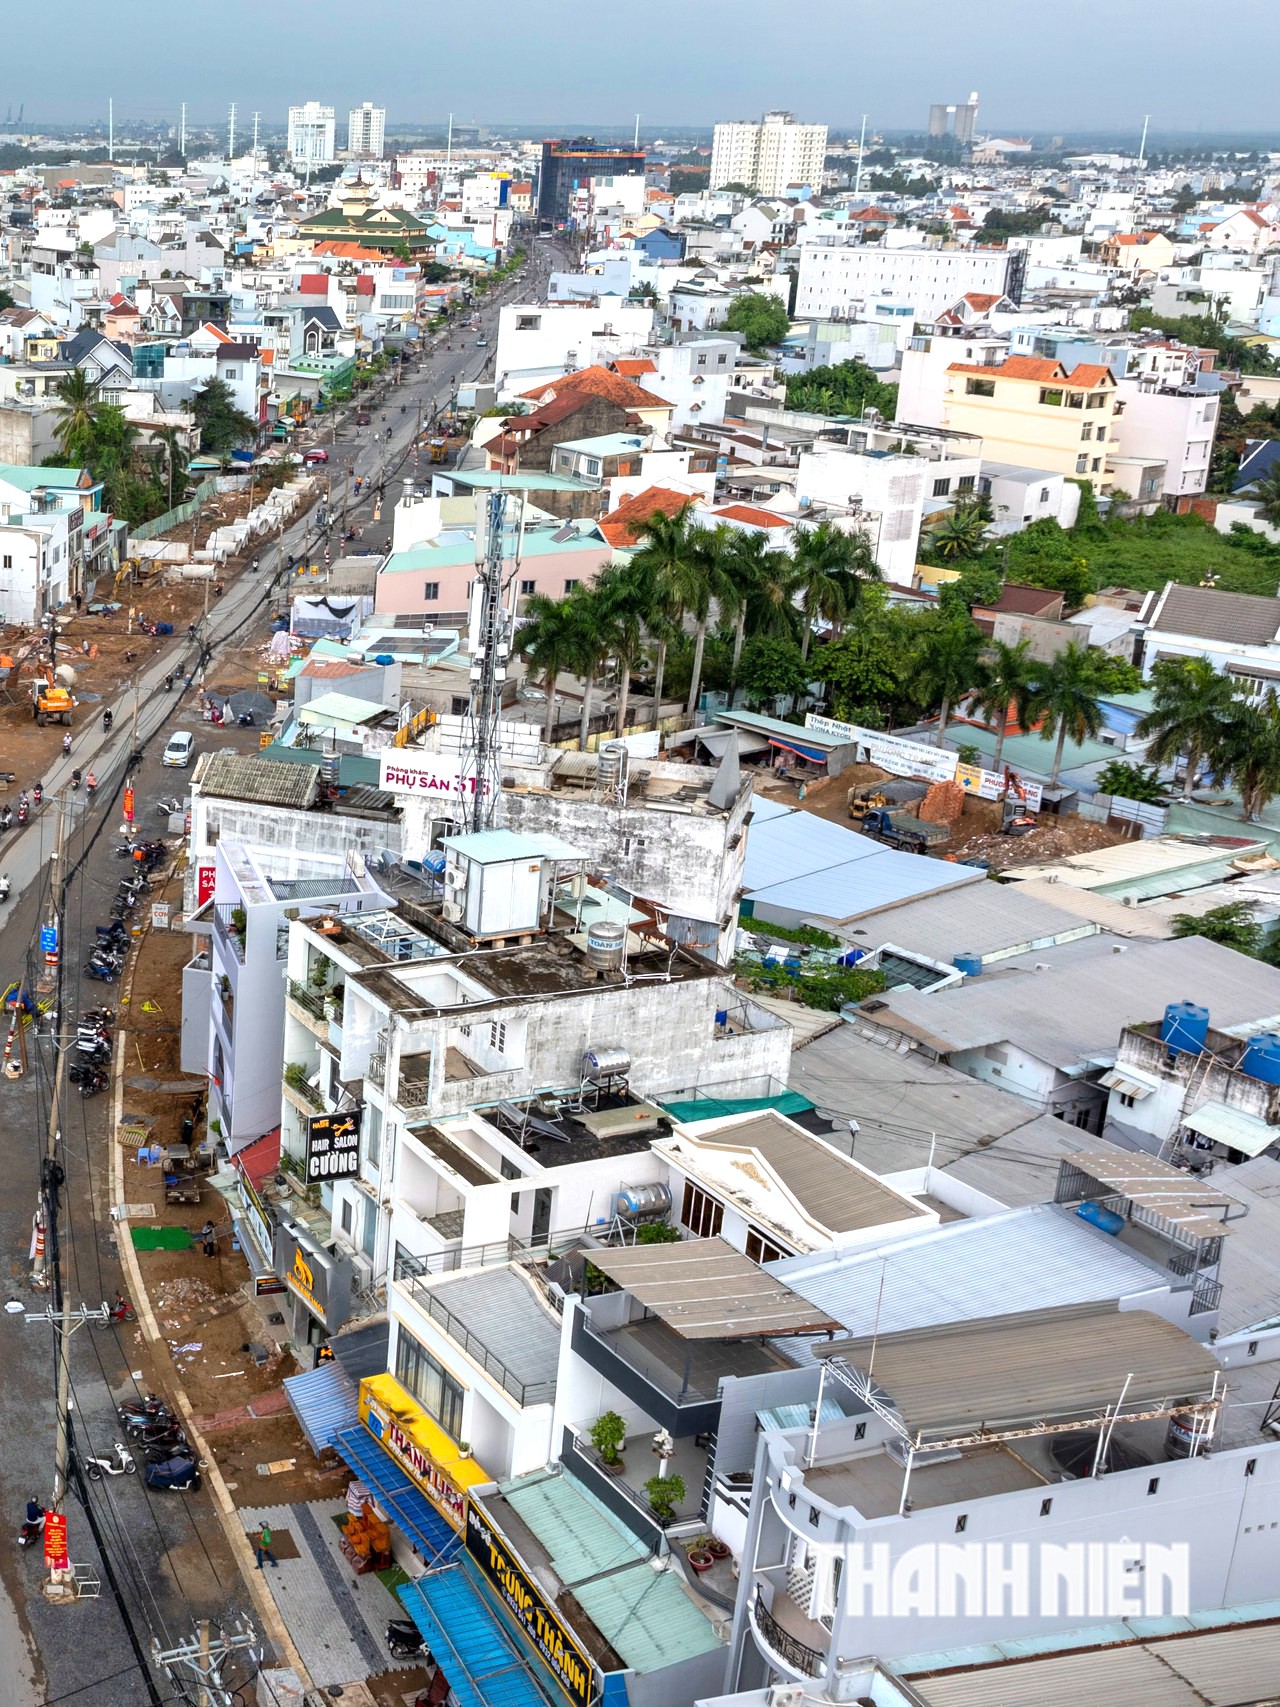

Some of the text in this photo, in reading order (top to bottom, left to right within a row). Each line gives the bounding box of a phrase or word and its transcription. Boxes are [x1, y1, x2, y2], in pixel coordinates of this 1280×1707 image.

[386, 765, 429, 776] Phòng khám
[385, 772, 416, 790] PHỤ
[418, 774, 451, 791] SẢN
[201, 877, 215, 888] SẢ
[202, 870, 216, 878] PH
[312, 1134, 358, 1152] HAIR SALON
[310, 1151, 358, 1177] CƯỜNG
[389, 1420, 434, 1483] THANH
[489, 1541, 587, 1698] TRUNG THÀNH
